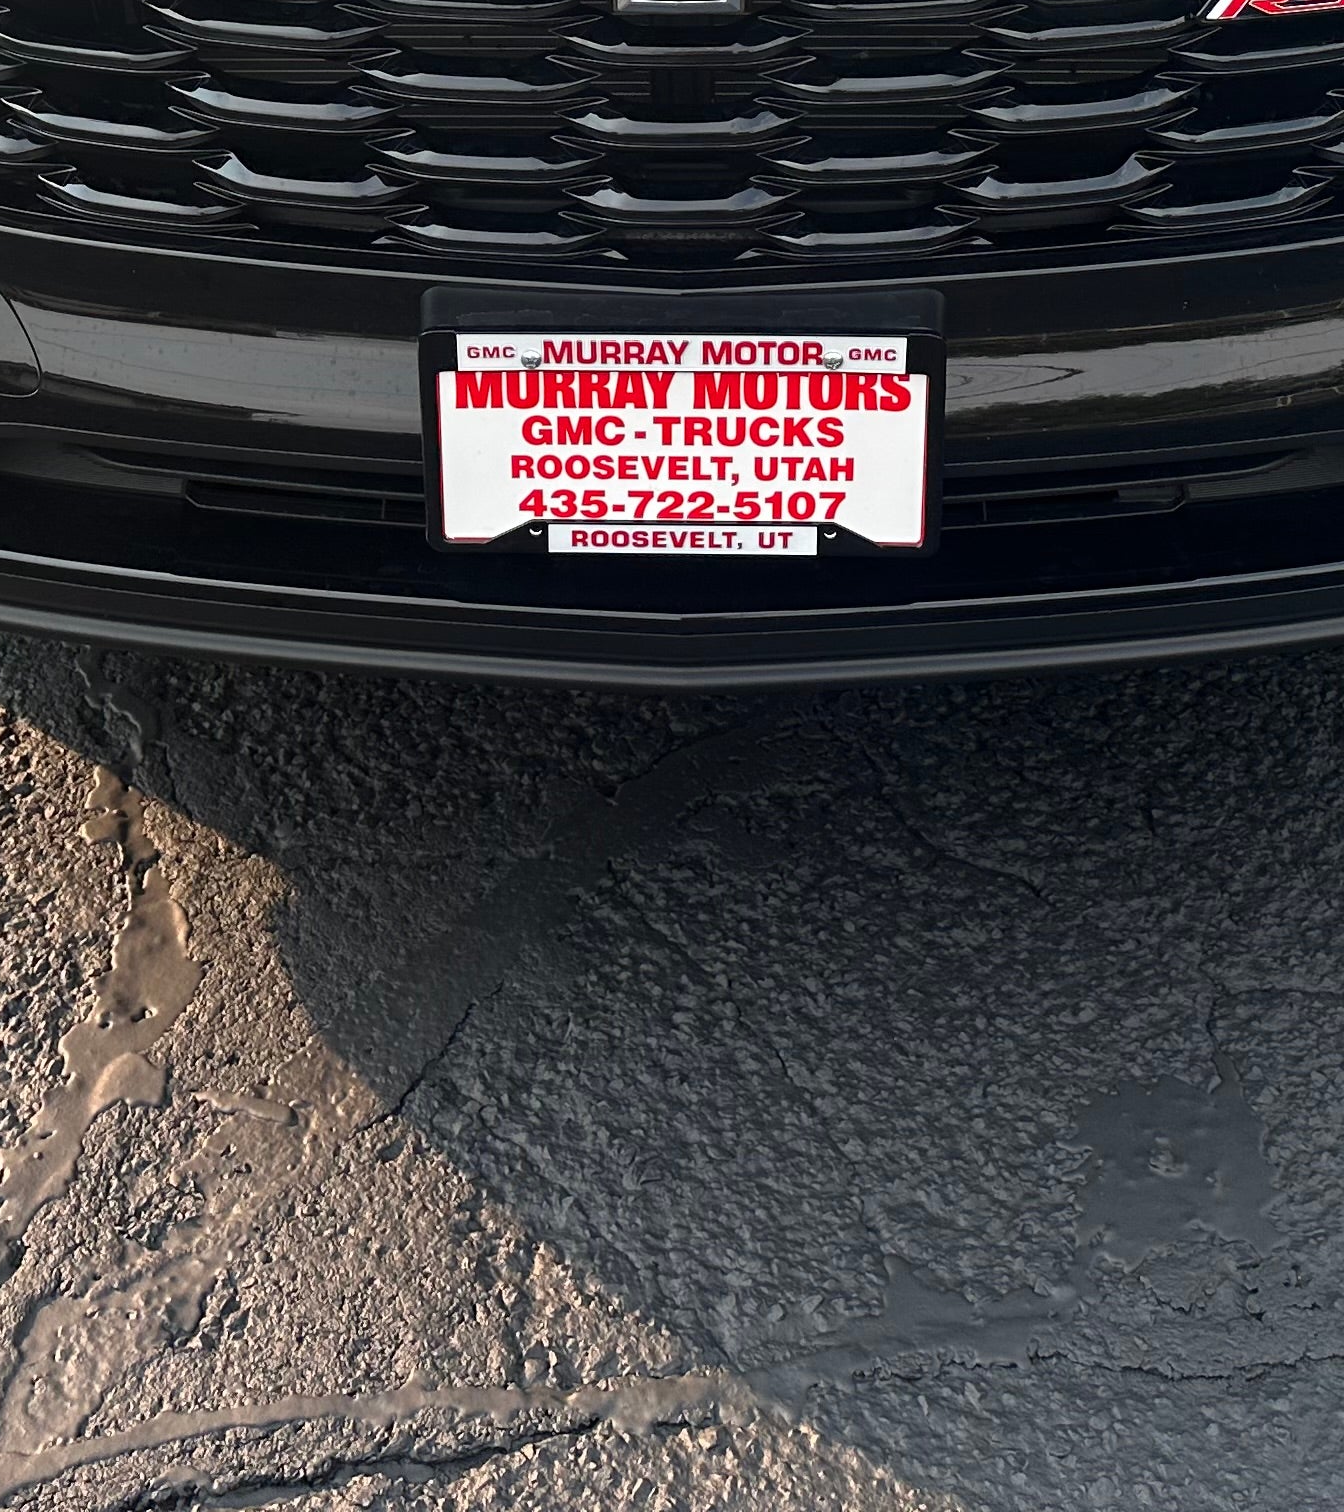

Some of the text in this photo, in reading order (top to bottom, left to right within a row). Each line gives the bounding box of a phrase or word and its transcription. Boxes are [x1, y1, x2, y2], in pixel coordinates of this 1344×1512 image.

[467, 340, 897, 366] GMC MURRAY MOTOR GMC
[456, 371, 912, 412] MURRAY MOTORS
[511, 455, 855, 486] ROOSEVELT, UTAH
[519, 489, 847, 520] 435-722-5107
[571, 531, 794, 550] ROOSEVELT, UT
